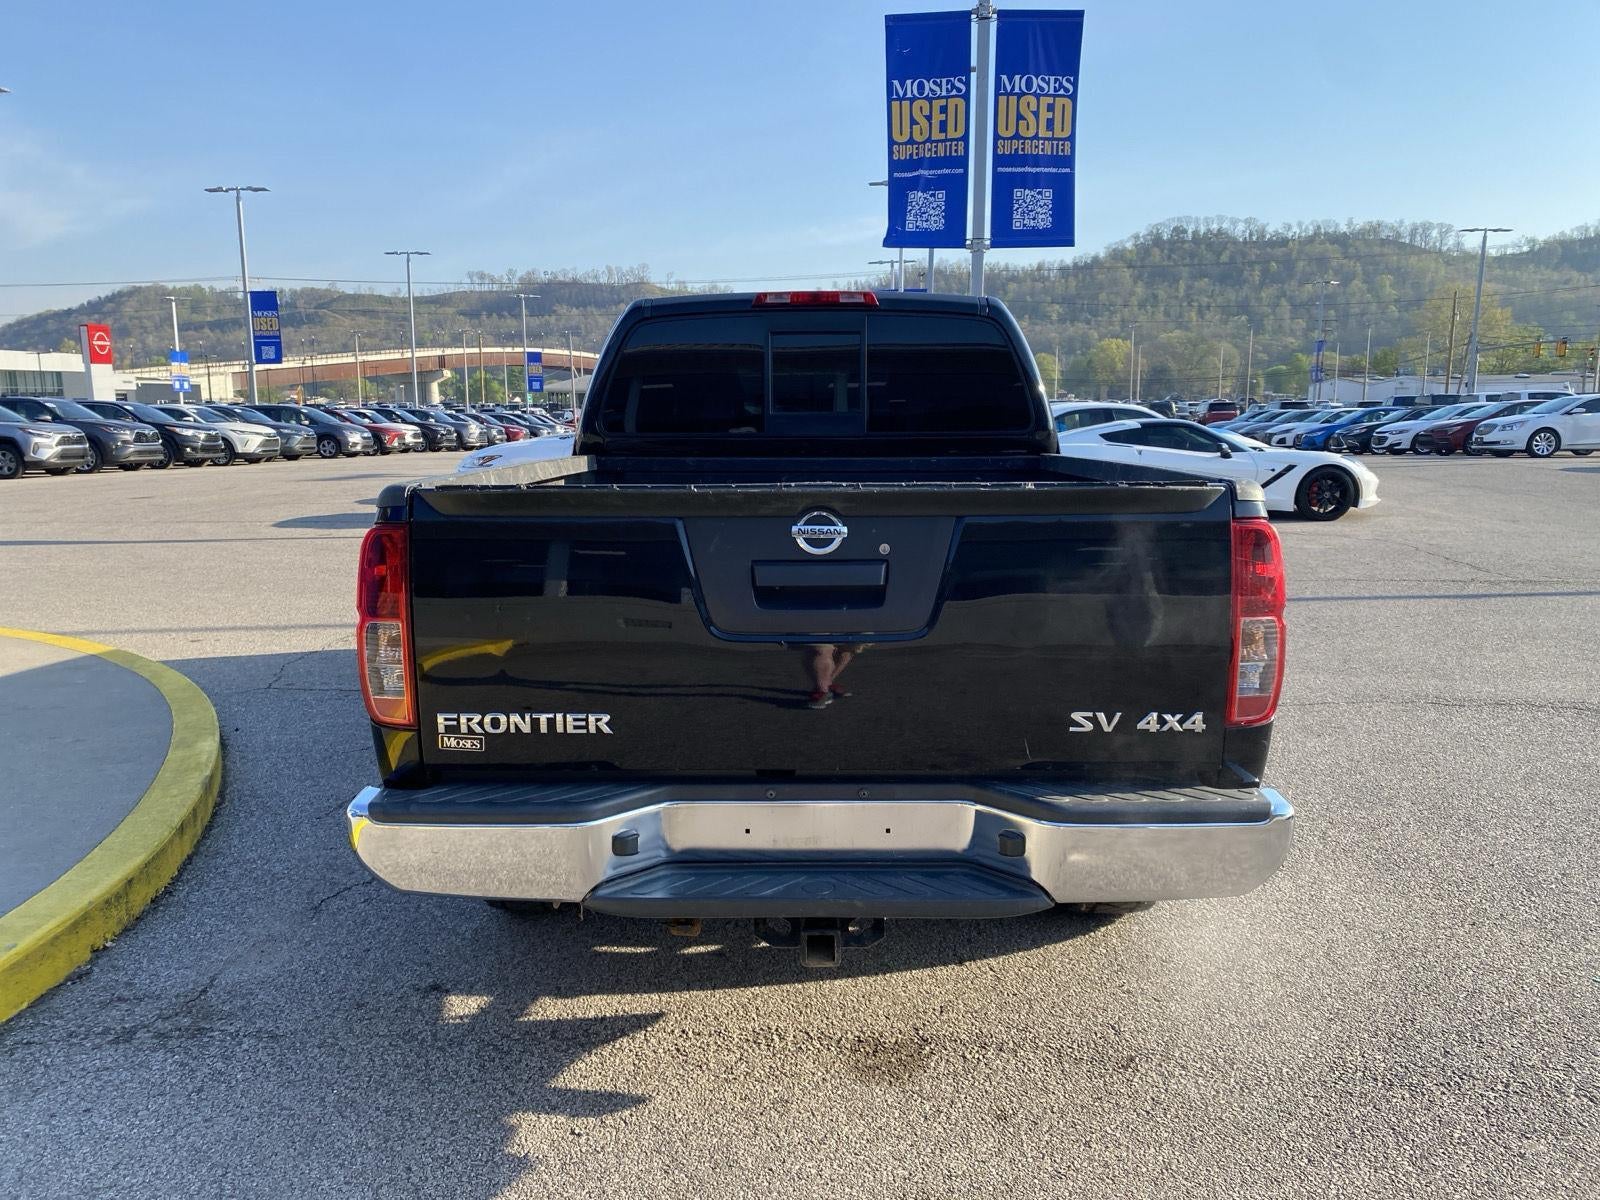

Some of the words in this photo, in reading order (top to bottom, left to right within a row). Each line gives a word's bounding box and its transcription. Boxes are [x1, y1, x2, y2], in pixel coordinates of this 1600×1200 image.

[892, 76, 966, 98] MOSES
[1000, 74, 1074, 95] MOSES
[891, 98, 966, 143] USED
[998, 95, 1072, 137] USED
[893, 141, 964, 160] SUPERCENTER
[997, 139, 1071, 156] SUPERCENTER
[253, 318, 279, 331] USED
[437, 713, 613, 734] FRONTIER
[1069, 712, 1122, 732] SV
[443, 737, 480, 749] MOSES
